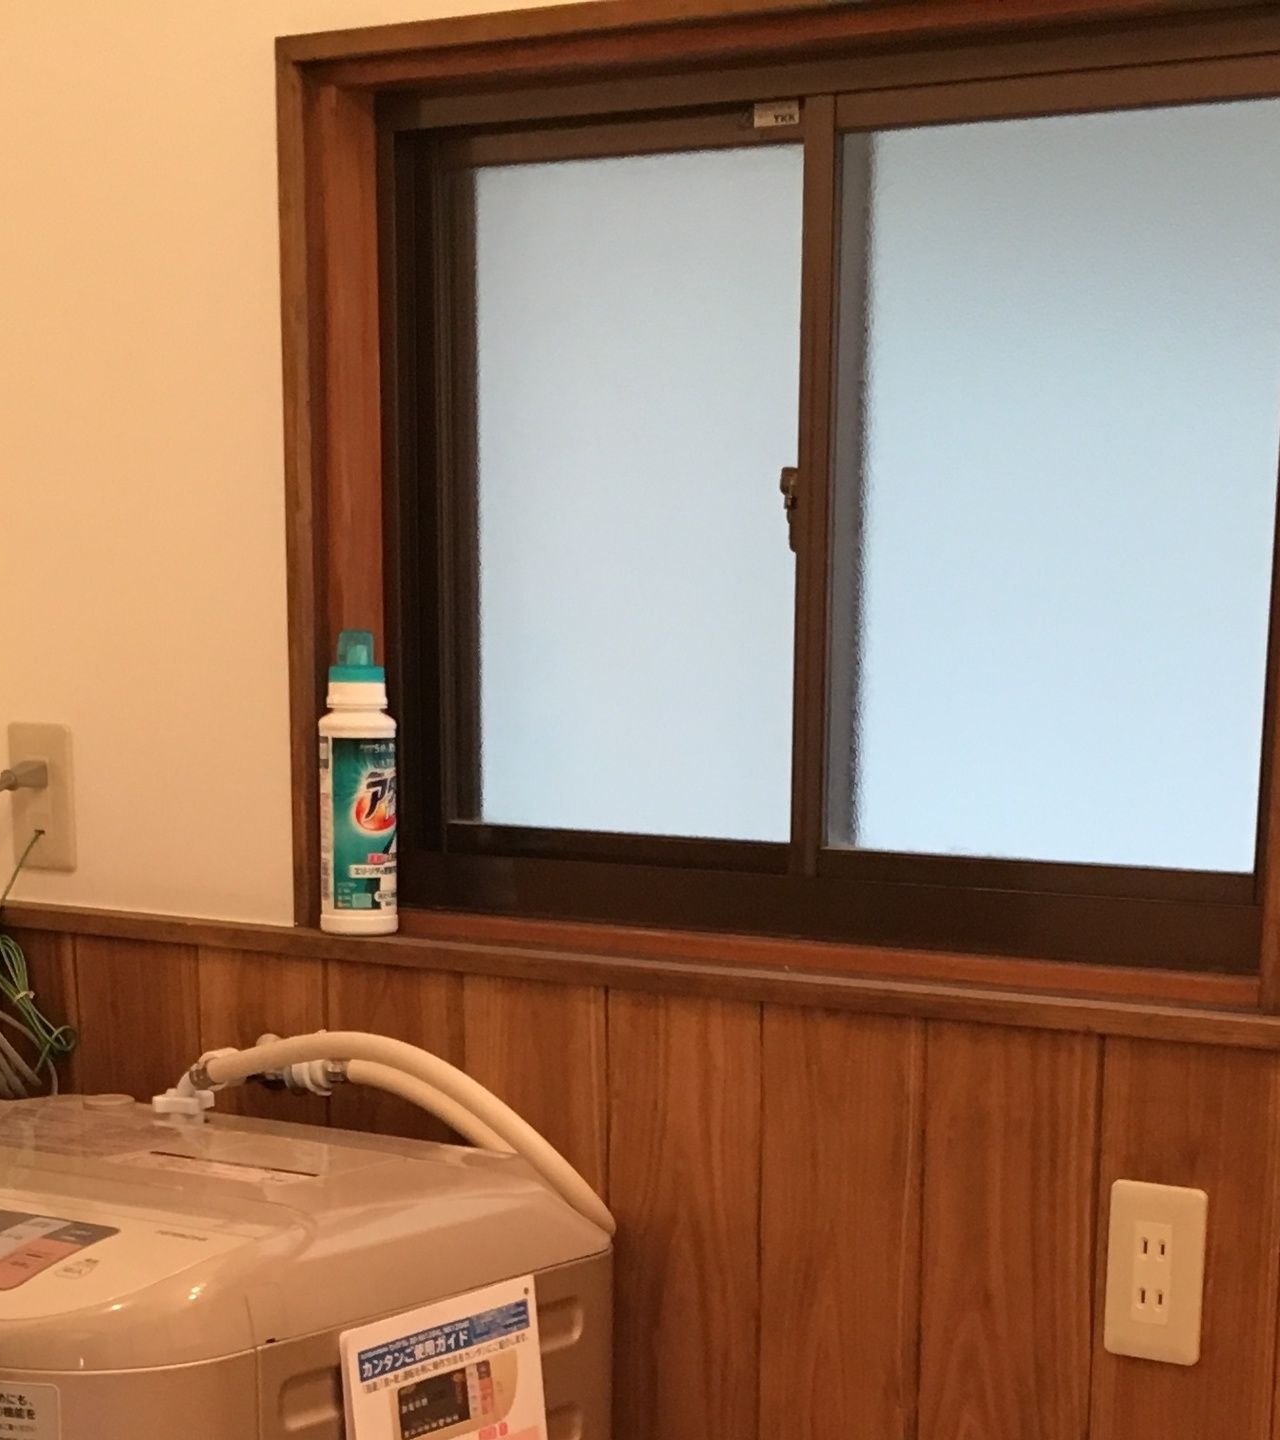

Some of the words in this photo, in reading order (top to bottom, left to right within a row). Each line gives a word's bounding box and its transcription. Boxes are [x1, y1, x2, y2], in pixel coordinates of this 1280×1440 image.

[773, 113, 796, 124] YKK
[362, 1330, 470, 1379] カンタンご使用ガイド
